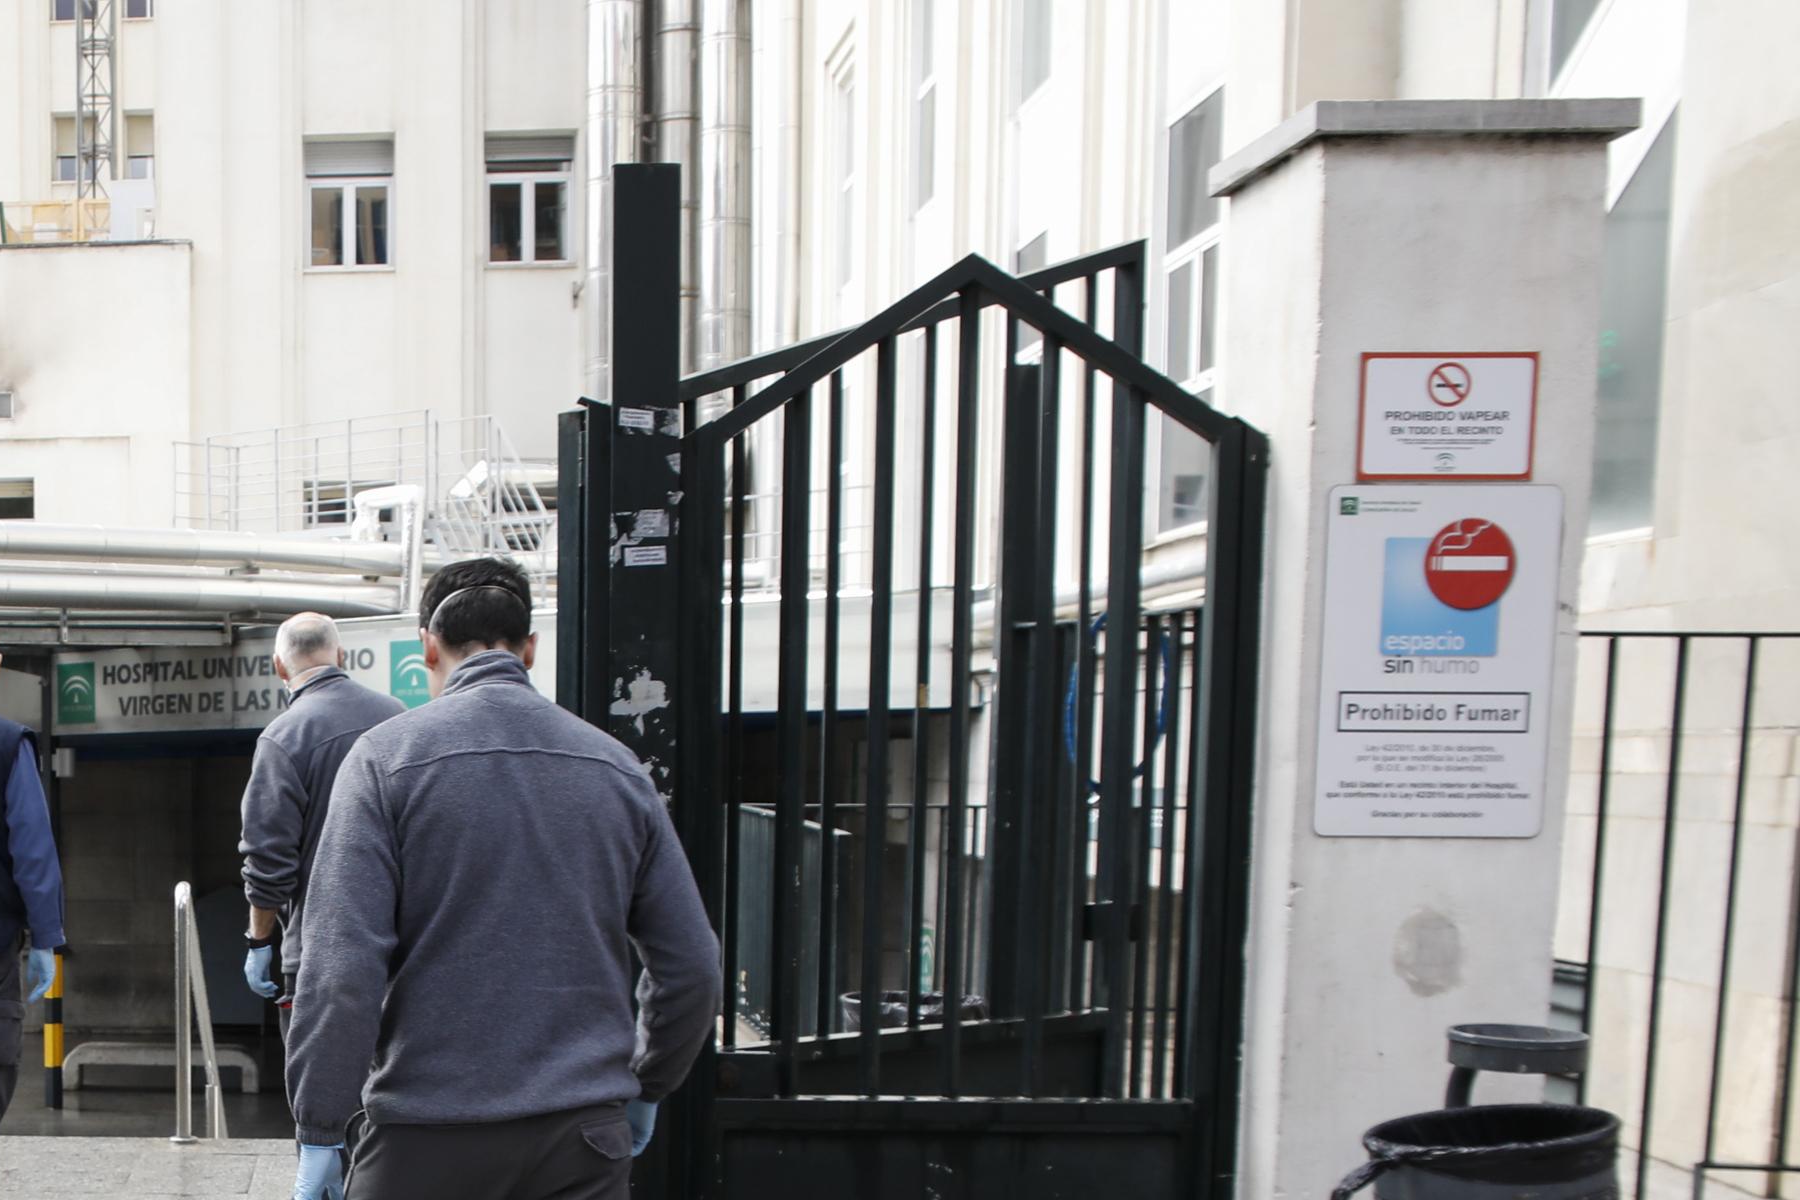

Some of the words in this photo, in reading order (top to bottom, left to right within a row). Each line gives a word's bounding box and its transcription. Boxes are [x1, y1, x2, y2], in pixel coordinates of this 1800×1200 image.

[1385, 411, 1456, 421] PROHIBIDO
[1459, 411, 1511, 421] VAPEAR
[1390, 426, 1404, 435] EN
[1408, 426, 1438, 435] TODO
[1441, 426, 1454, 435] EL
[1457, 426, 1504, 435] RECINTO
[1384, 630, 1465, 654] espacio
[103, 660, 198, 685] HOSPITAL
[1383, 654, 1414, 674] sin
[1419, 657, 1480, 674] humo
[118, 692, 193, 717] VIRGEN
[198, 691, 225, 713] DE
[232, 688, 272, 711] LAS
[1346, 703, 1448, 721] Prohibido
[1455, 704, 1521, 721] Fumar
